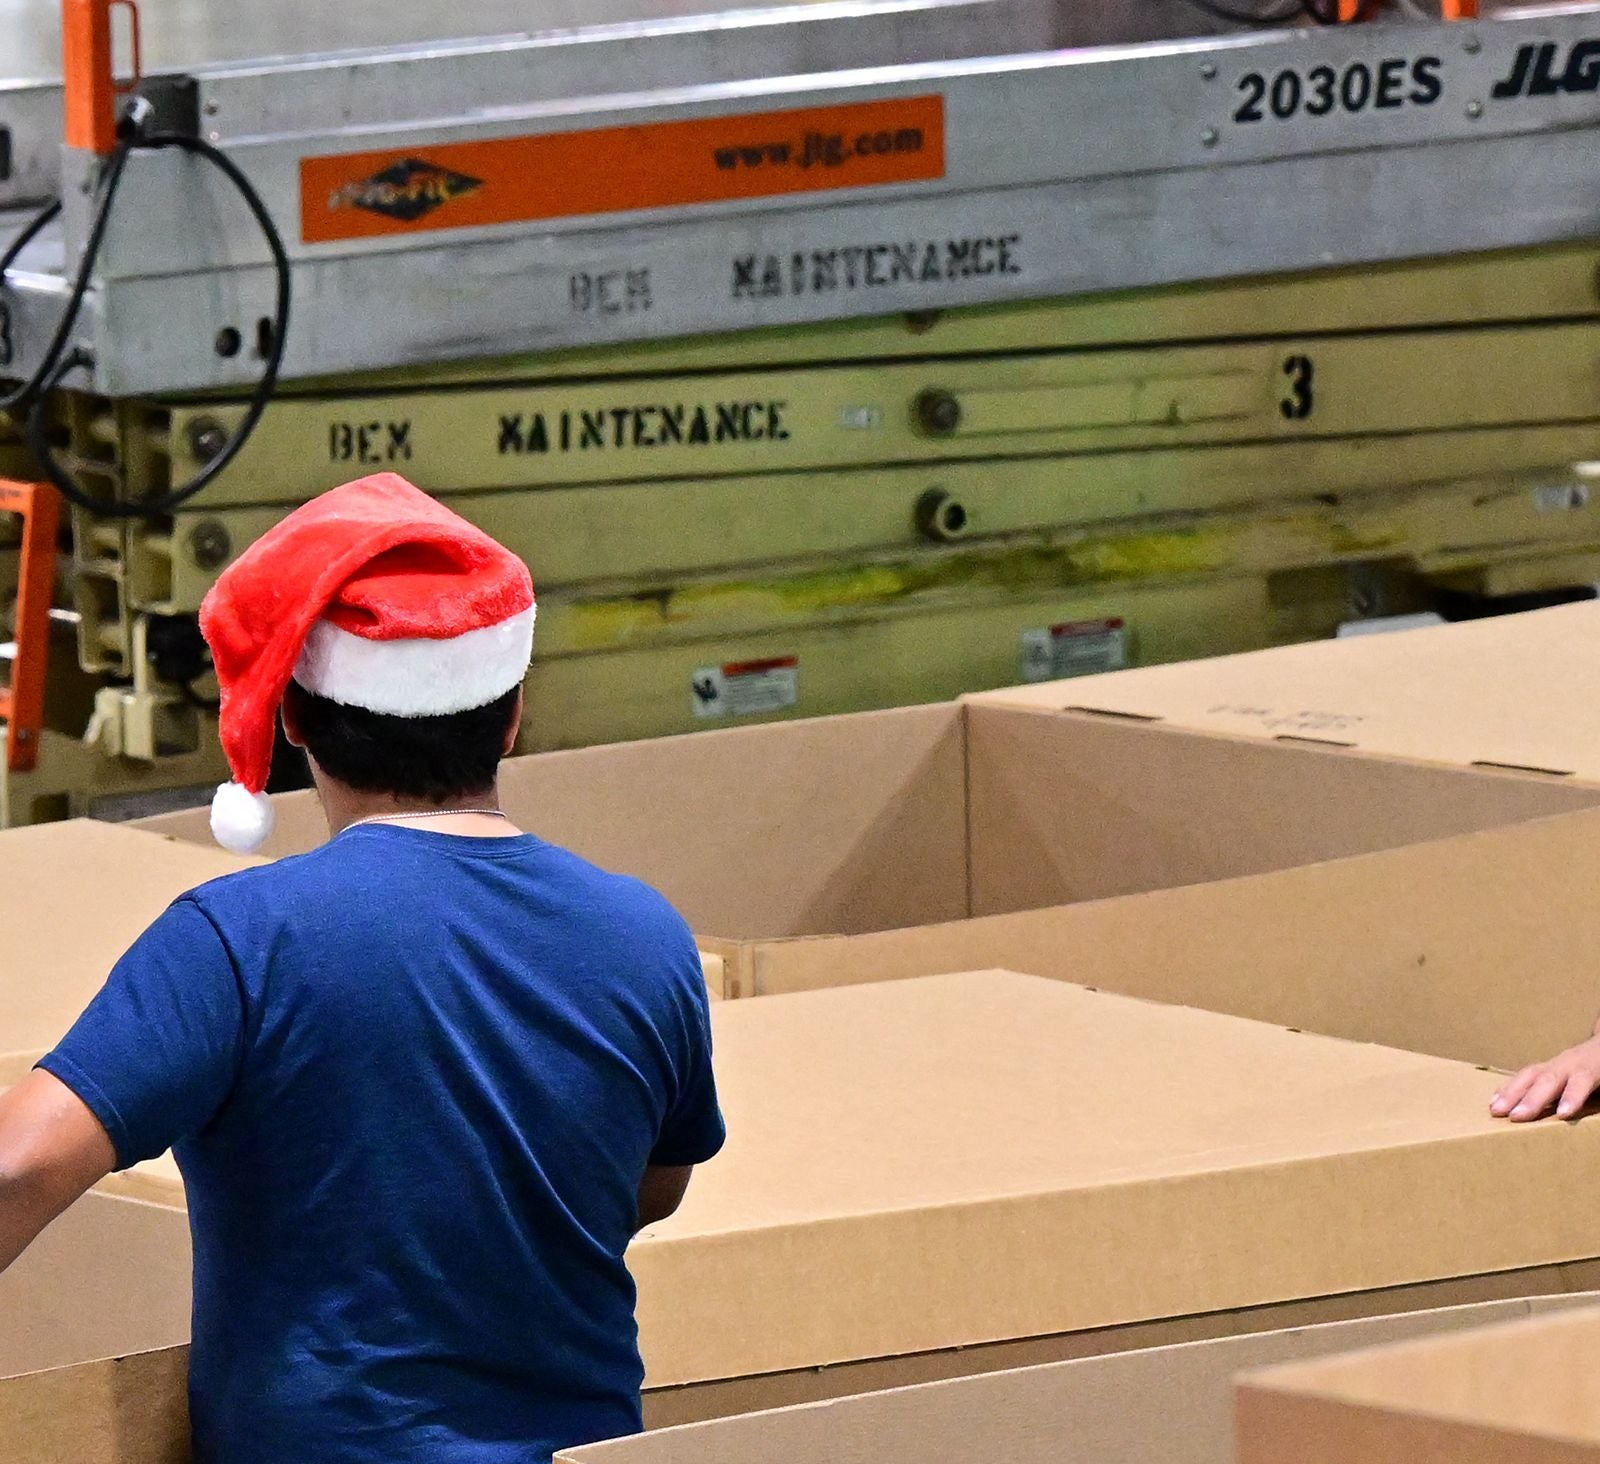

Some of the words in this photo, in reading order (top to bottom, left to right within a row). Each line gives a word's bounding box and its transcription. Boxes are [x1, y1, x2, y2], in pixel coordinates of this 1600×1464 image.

[1232, 54, 1443, 123] 2030ES
[713, 127, 924, 171] www.jlg.com
[731, 233, 1021, 298] MAINTENANCE
[1279, 355, 1314, 420] 3
[497, 401, 791, 456] MAINTENANCE
